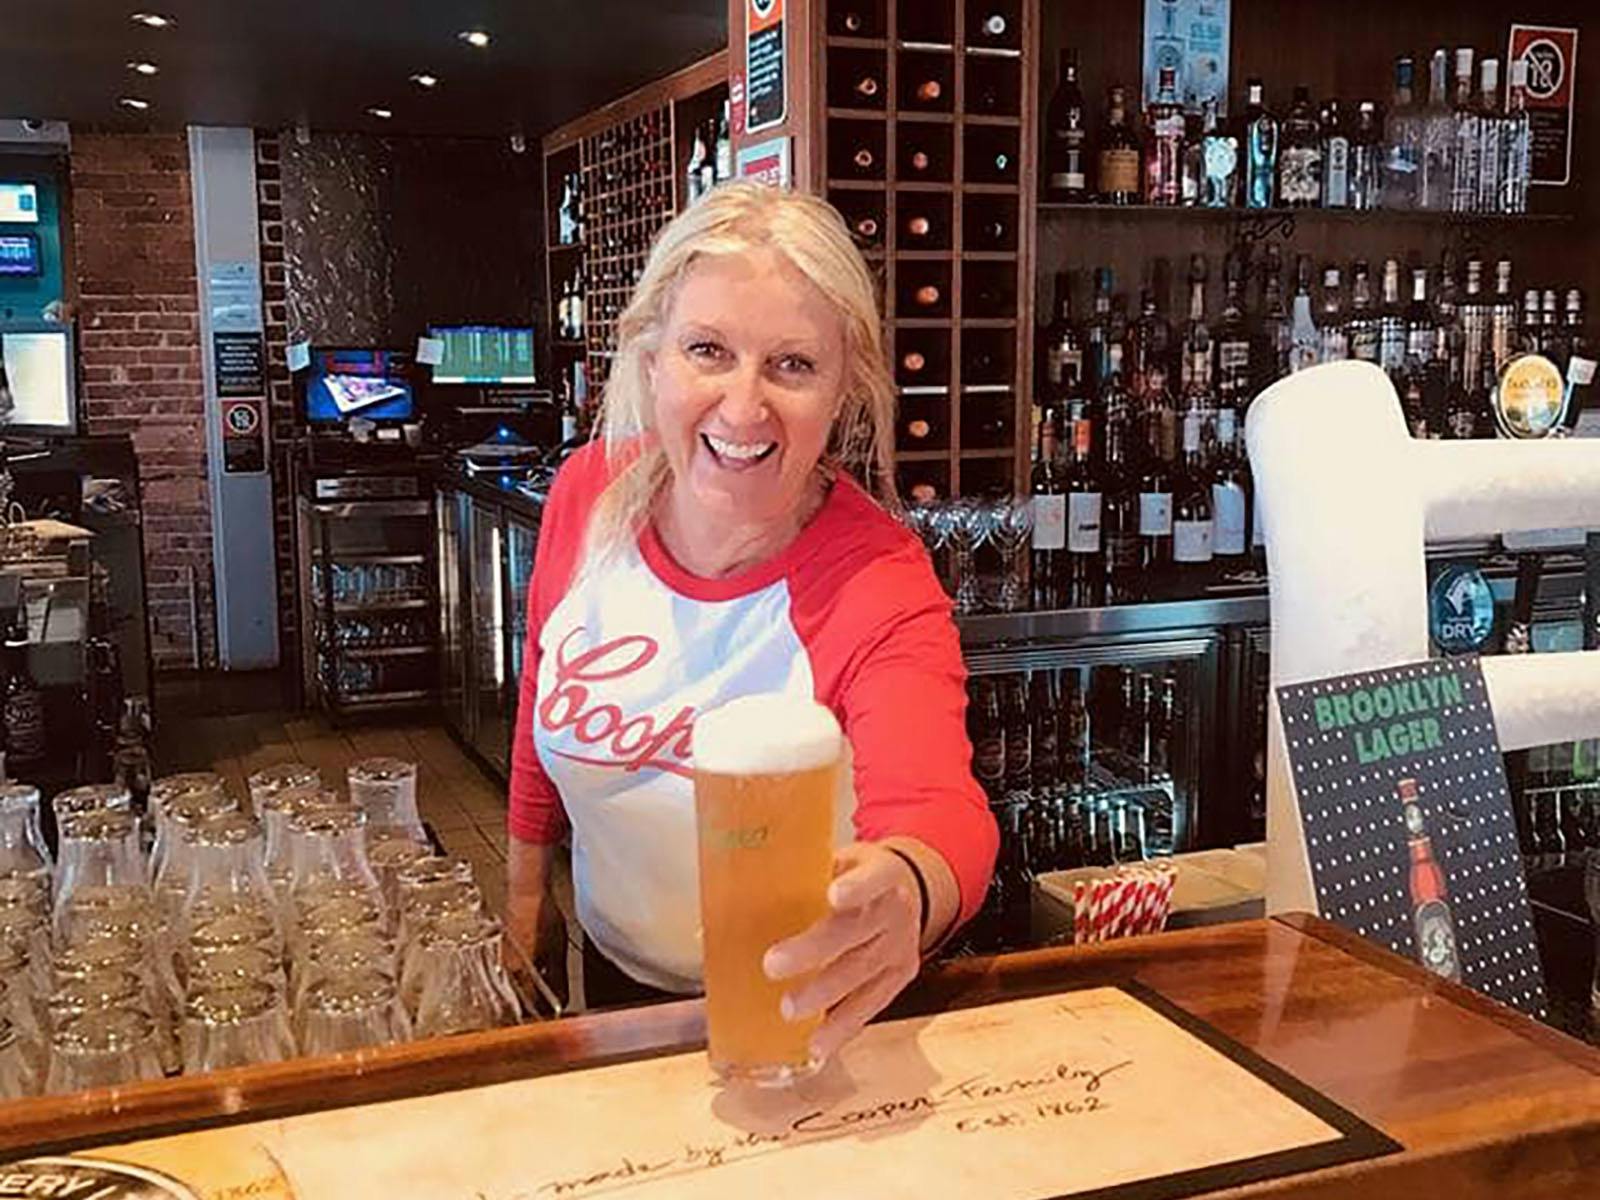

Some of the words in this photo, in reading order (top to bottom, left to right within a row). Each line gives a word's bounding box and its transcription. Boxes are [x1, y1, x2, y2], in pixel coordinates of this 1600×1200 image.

[1442, 623, 1476, 639] DRY
[539, 626, 695, 772] Coop
[1315, 674, 1462, 730] BROOKLYN
[1354, 718, 1443, 764] LAGER
[792, 1096, 936, 1134] Cooper
[941, 1060, 1134, 1100] Family
[0, 1173, 96, 1197] ERY
